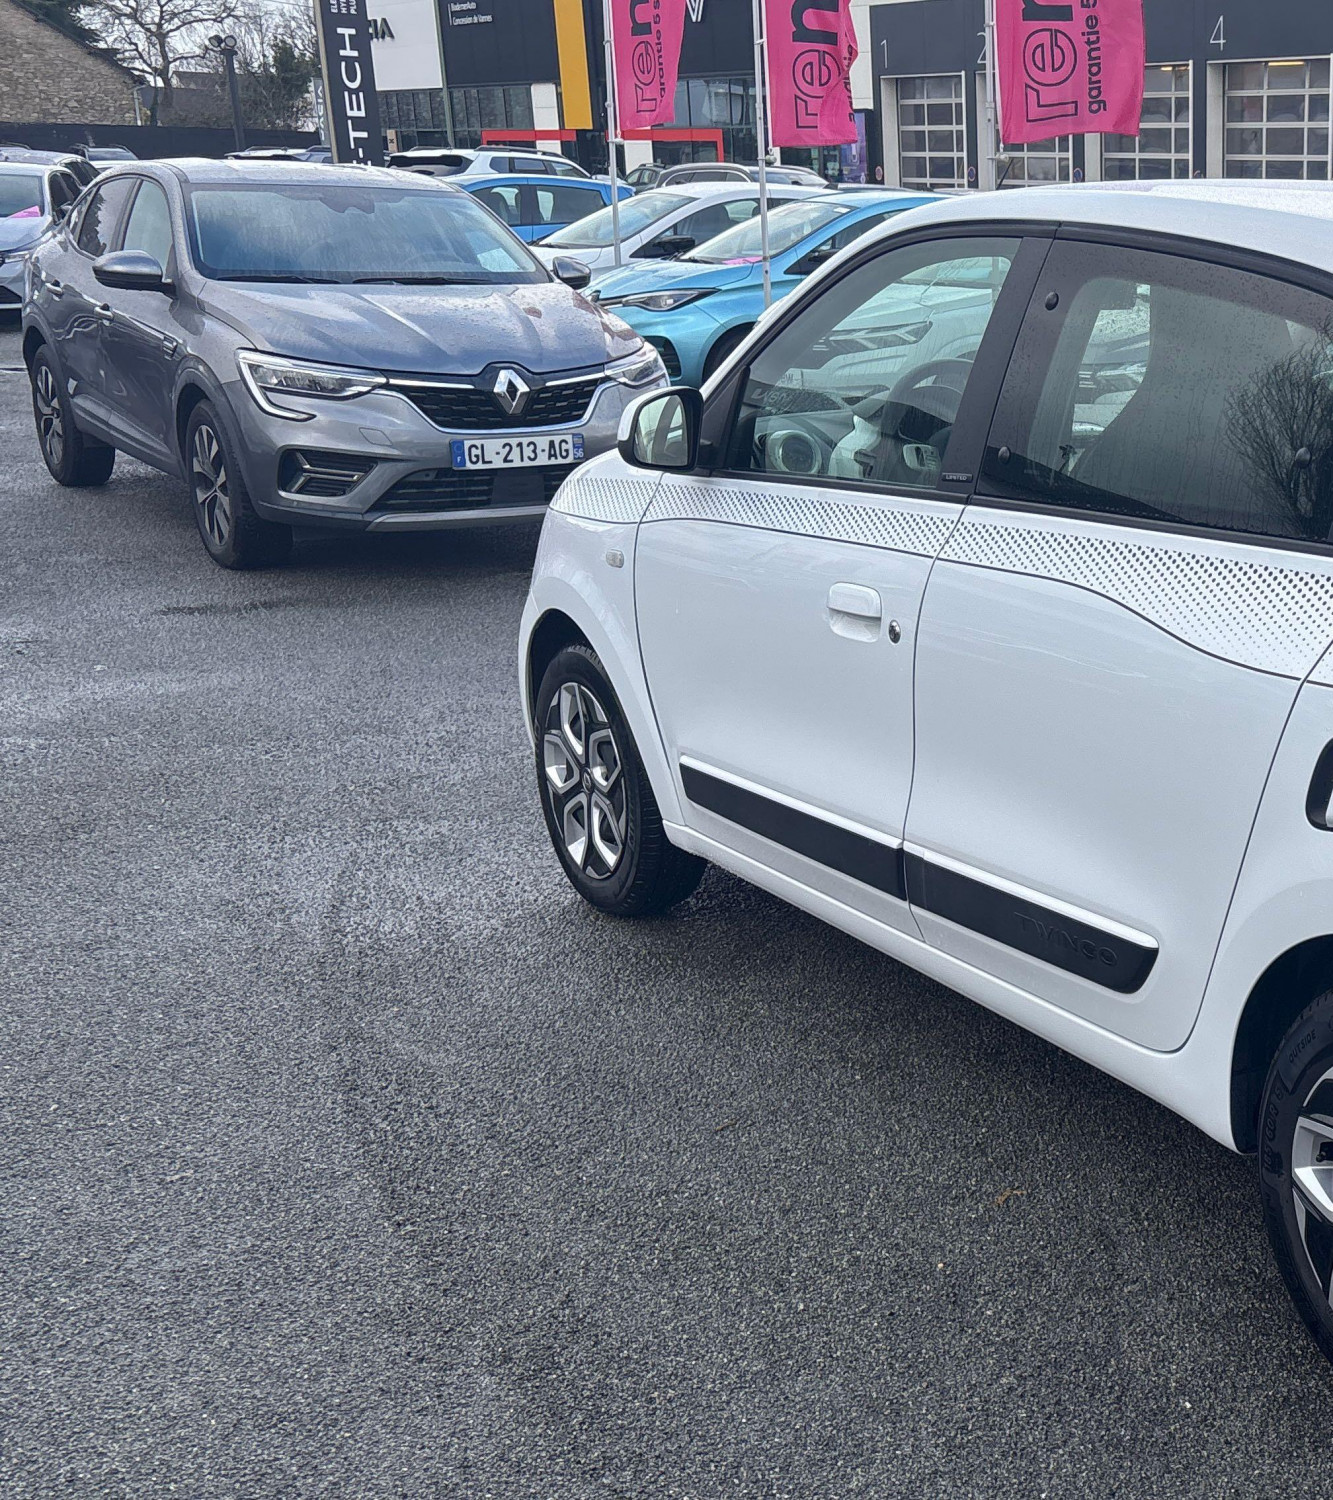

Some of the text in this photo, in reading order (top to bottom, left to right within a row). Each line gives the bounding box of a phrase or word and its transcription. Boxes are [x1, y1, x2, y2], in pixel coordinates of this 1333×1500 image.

[1209, 15, 1227, 51] 4
[880, 39, 888, 69] 1
[1081, 14, 1107, 115] garantie
[467, 438, 570, 466] GL-213-AG
[573, 447, 584, 459] 56
[1013, 911, 1119, 968] TWINGO
[1288, 1028, 1317, 1063] OUTSIDE
